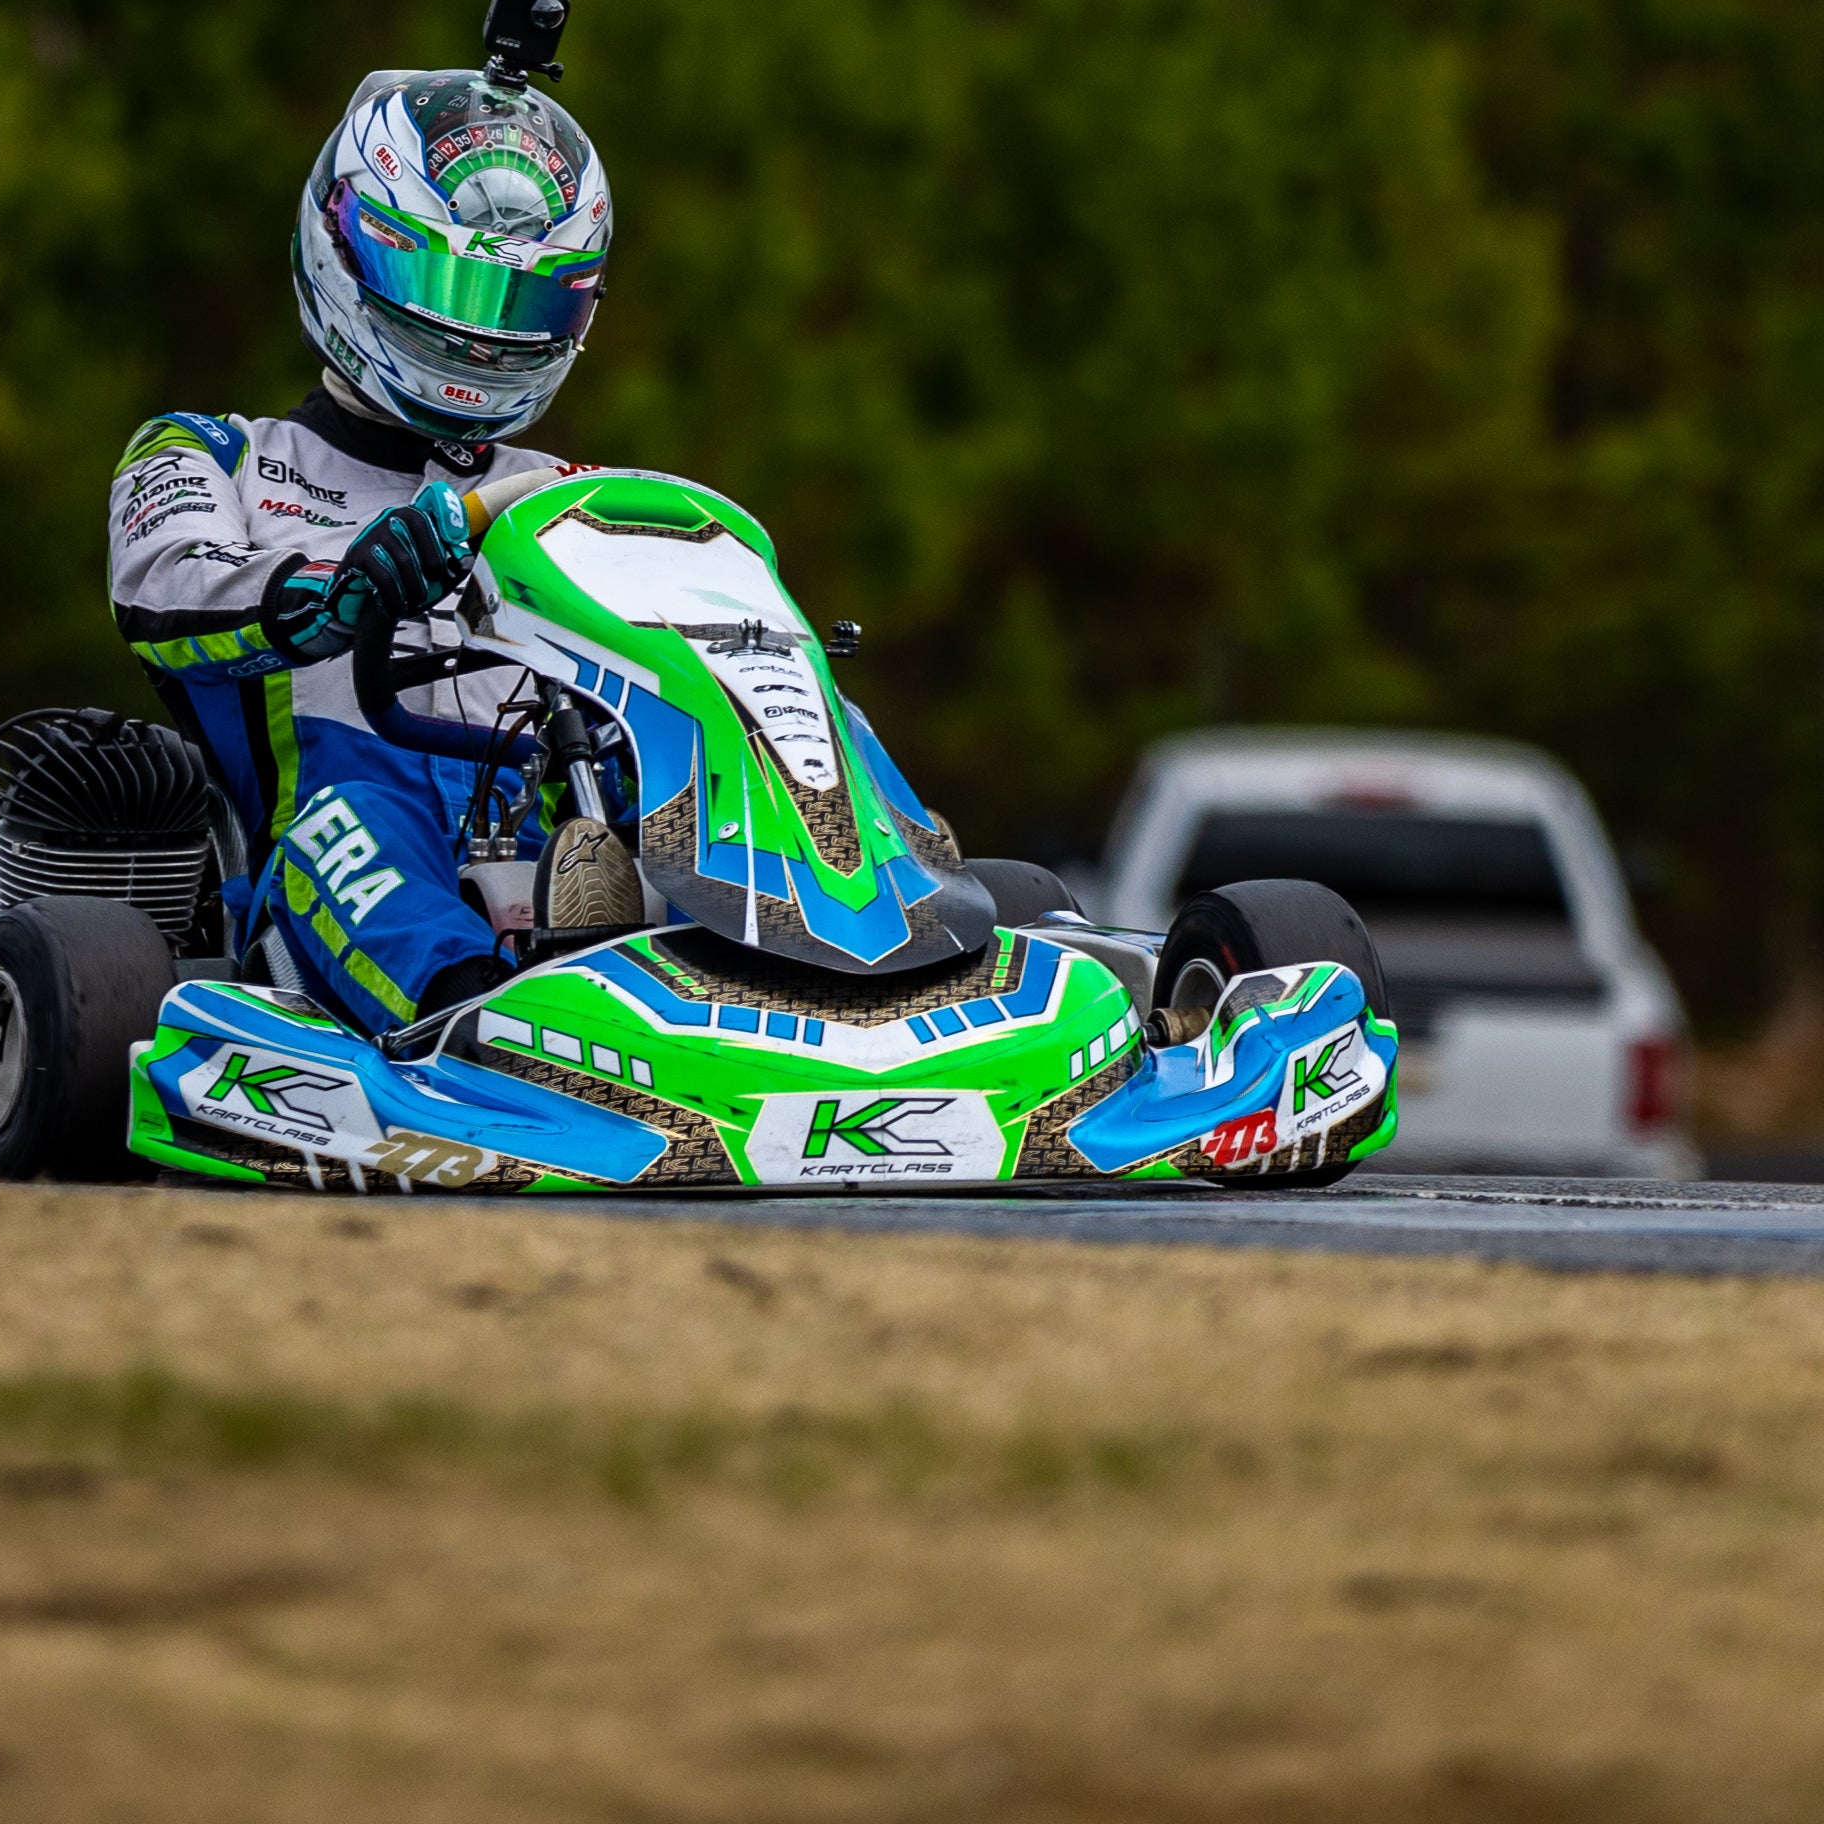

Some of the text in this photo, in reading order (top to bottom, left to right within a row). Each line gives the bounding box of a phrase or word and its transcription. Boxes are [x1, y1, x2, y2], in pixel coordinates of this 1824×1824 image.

[376, 147, 399, 177] BELL
[440, 142, 456, 156] 12
[457, 132, 471, 149] 35
[549, 155, 562, 170] 19
[444, 385, 484, 403] BELL
[203, 1051, 354, 1133] KC
[1293, 1027, 1363, 1116] KC
[195, 1103, 332, 1147] KARTCLASS
[801, 1098, 958, 1159] KC
[1296, 1083, 1371, 1131] KARTCLASS
[799, 1163, 954, 1177] KARTCLASS
